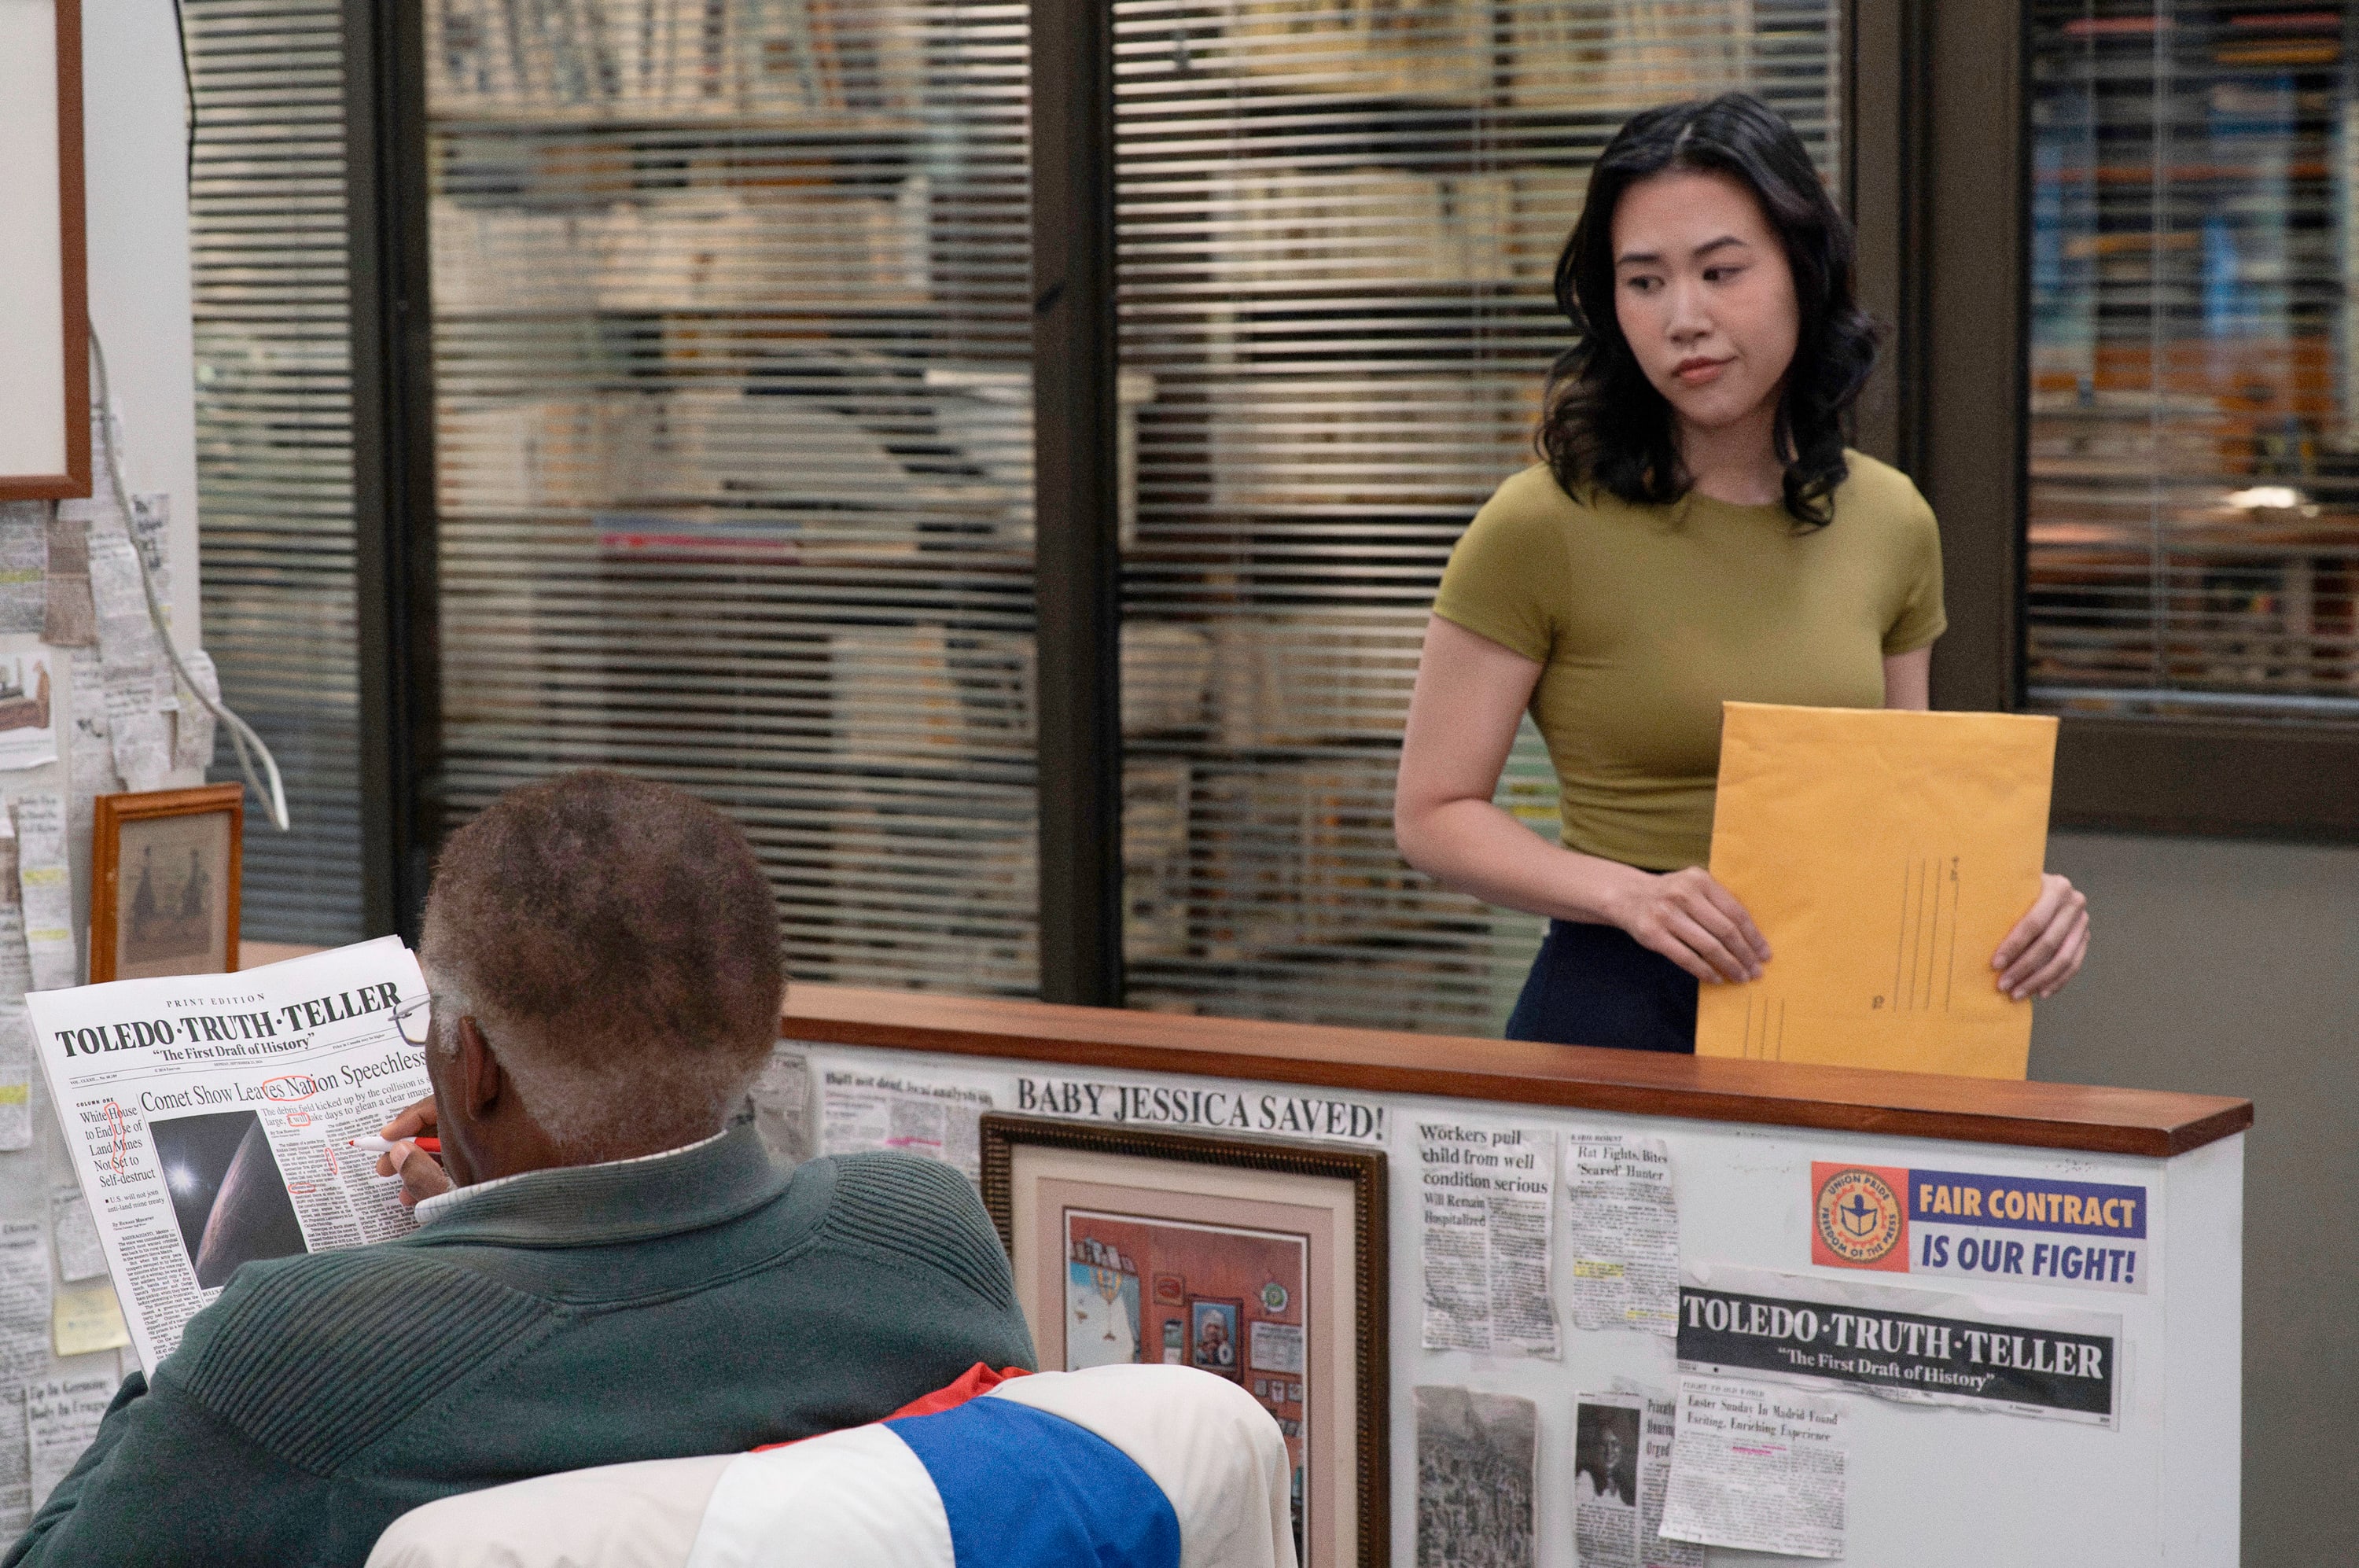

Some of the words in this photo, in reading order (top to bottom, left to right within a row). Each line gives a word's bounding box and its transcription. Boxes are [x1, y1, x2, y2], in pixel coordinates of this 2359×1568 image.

[167, 998, 204, 1007] PRINT
[212, 993, 265, 1006] EDITION
[186, 1047, 213, 1059] First
[216, 1043, 245, 1056] Draft
[248, 1038, 261, 1055] of
[141, 1089, 193, 1112] Comet
[193, 1082, 232, 1105] Show
[234, 1081, 285, 1102] Leaves
[285, 1073, 339, 1097] Nation
[340, 1051, 426, 1088] Speechless
[262, 1107, 276, 1118] The
[277, 1106, 298, 1117] debris
[298, 1103, 315, 1114] field
[316, 1099, 342, 1110] kicked
[344, 1097, 354, 1107] up
[355, 1091, 366, 1103] by
[366, 1088, 381, 1097] the
[381, 1081, 415, 1095] collision
[267, 1116, 286, 1128] large,
[293, 1113, 307, 1124] will
[325, 1108, 344, 1121] days
[355, 1100, 377, 1115] glean
[385, 1093, 405, 1106] clear
[407, 1088, 432, 1101] image
[1018, 1078, 1104, 1115] BABY
[1113, 1086, 1250, 1127] JESSICA
[1259, 1095, 1384, 1140] SAVED!
[79, 1109, 108, 1124] White
[108, 1106, 138, 1120] House
[86, 1130, 94, 1140] to
[95, 1125, 113, 1139] End
[114, 1124, 131, 1136] Use
[133, 1120, 143, 1132] of
[1420, 1124, 1488, 1143] Workers
[1492, 1129, 1521, 1147] pull
[89, 1141, 112, 1156] Land
[113, 1139, 142, 1152] Mines
[1422, 1147, 1459, 1164] child
[1464, 1148, 1499, 1166] from
[1503, 1153, 1535, 1169] well
[1642, 1149, 1668, 1164] Bites
[93, 1159, 112, 1172] Not
[112, 1156, 128, 1169] Set
[130, 1156, 139, 1165] to
[1626, 1165, 1664, 1180] Hunter
[99, 1169, 156, 1187] Self-destruct
[1423, 1170, 1492, 1189] condition
[1494, 1176, 1548, 1194] serious
[1827, 1175, 1861, 1195] UNION
[1864, 1176, 1890, 1200] PRIDE
[108, 1204, 132, 1213] anti-land
[149, 1198, 165, 1207] treaty
[1919, 1183, 1982, 1216] FAIR
[1988, 1189, 2136, 1228] CONTRACT
[1822, 1207, 1847, 1253] FREEDOM
[1867, 1243, 1883, 1256] THE
[1883, 1213, 1897, 1243] PRESS
[1922, 1234, 1950, 1268] IS
[1957, 1237, 2025, 1274] OUR
[2032, 1243, 2136, 1284] FIGHT!
[1817, 1353, 1856, 1373] First
[1857, 1360, 1901, 1378] Draft
[1904, 1364, 1923, 1380] of
[1757, 1403, 1768, 1415] In
[1773, 1404, 1805, 1420] Madrid
[1730, 1416, 1777, 1437] Enriching
[1780, 1423, 1831, 1442] Experience
